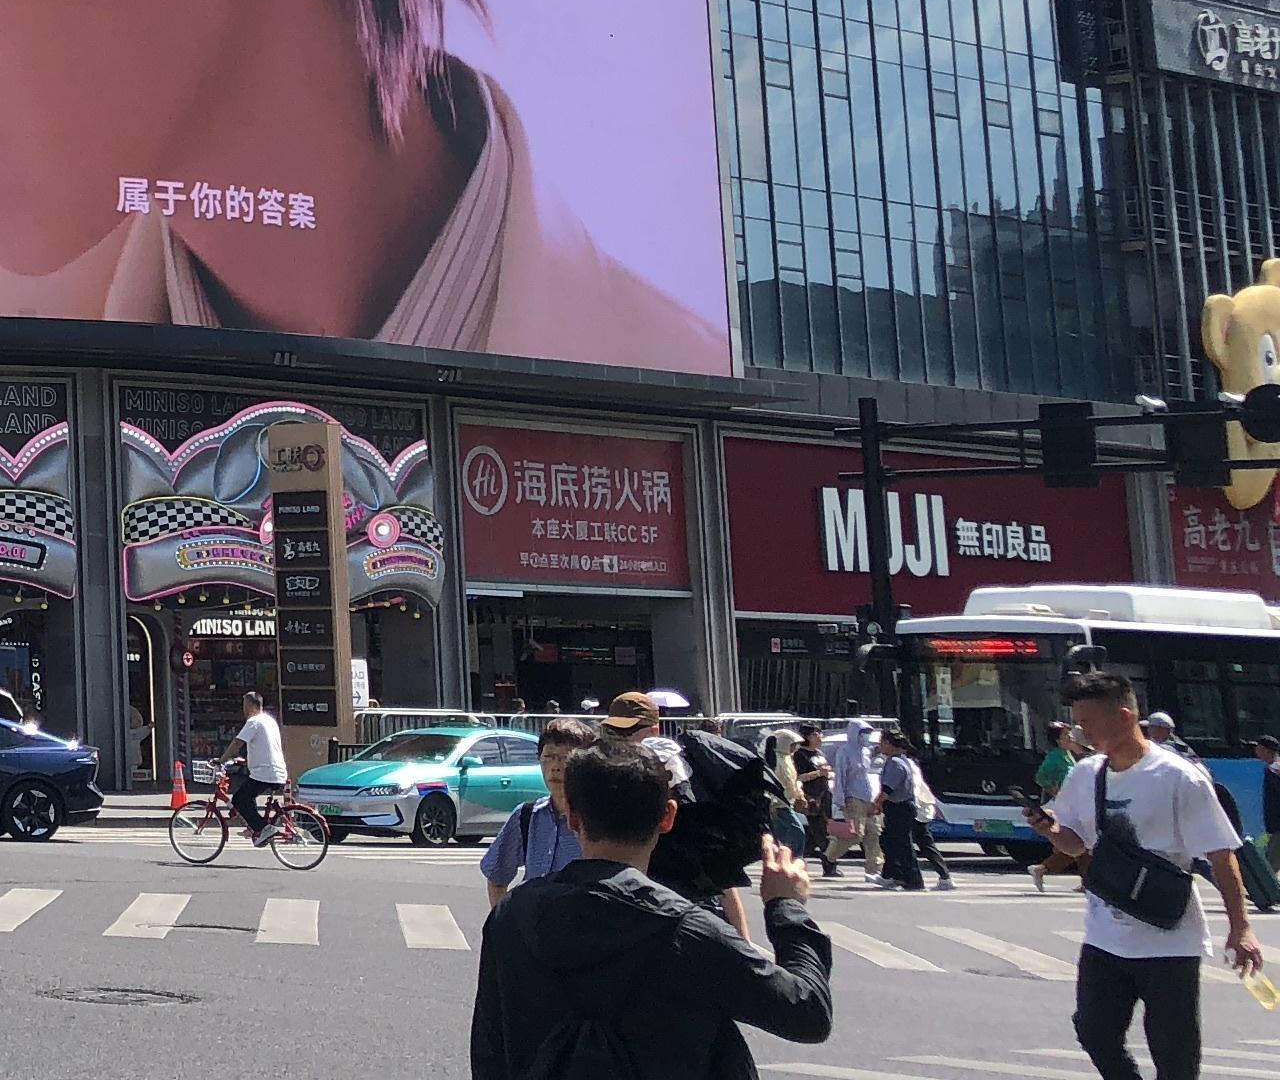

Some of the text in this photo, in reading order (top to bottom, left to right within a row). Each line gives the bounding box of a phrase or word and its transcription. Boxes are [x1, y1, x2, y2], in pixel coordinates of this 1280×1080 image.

[116, 176, 317, 230] 属于你的答案
[513, 460, 672, 515] 海底捞火锅
[641, 525, 658, 544] 5F
[955, 517, 1052, 563] 無印良品
[1183, 504, 1261, 552] 高老九
